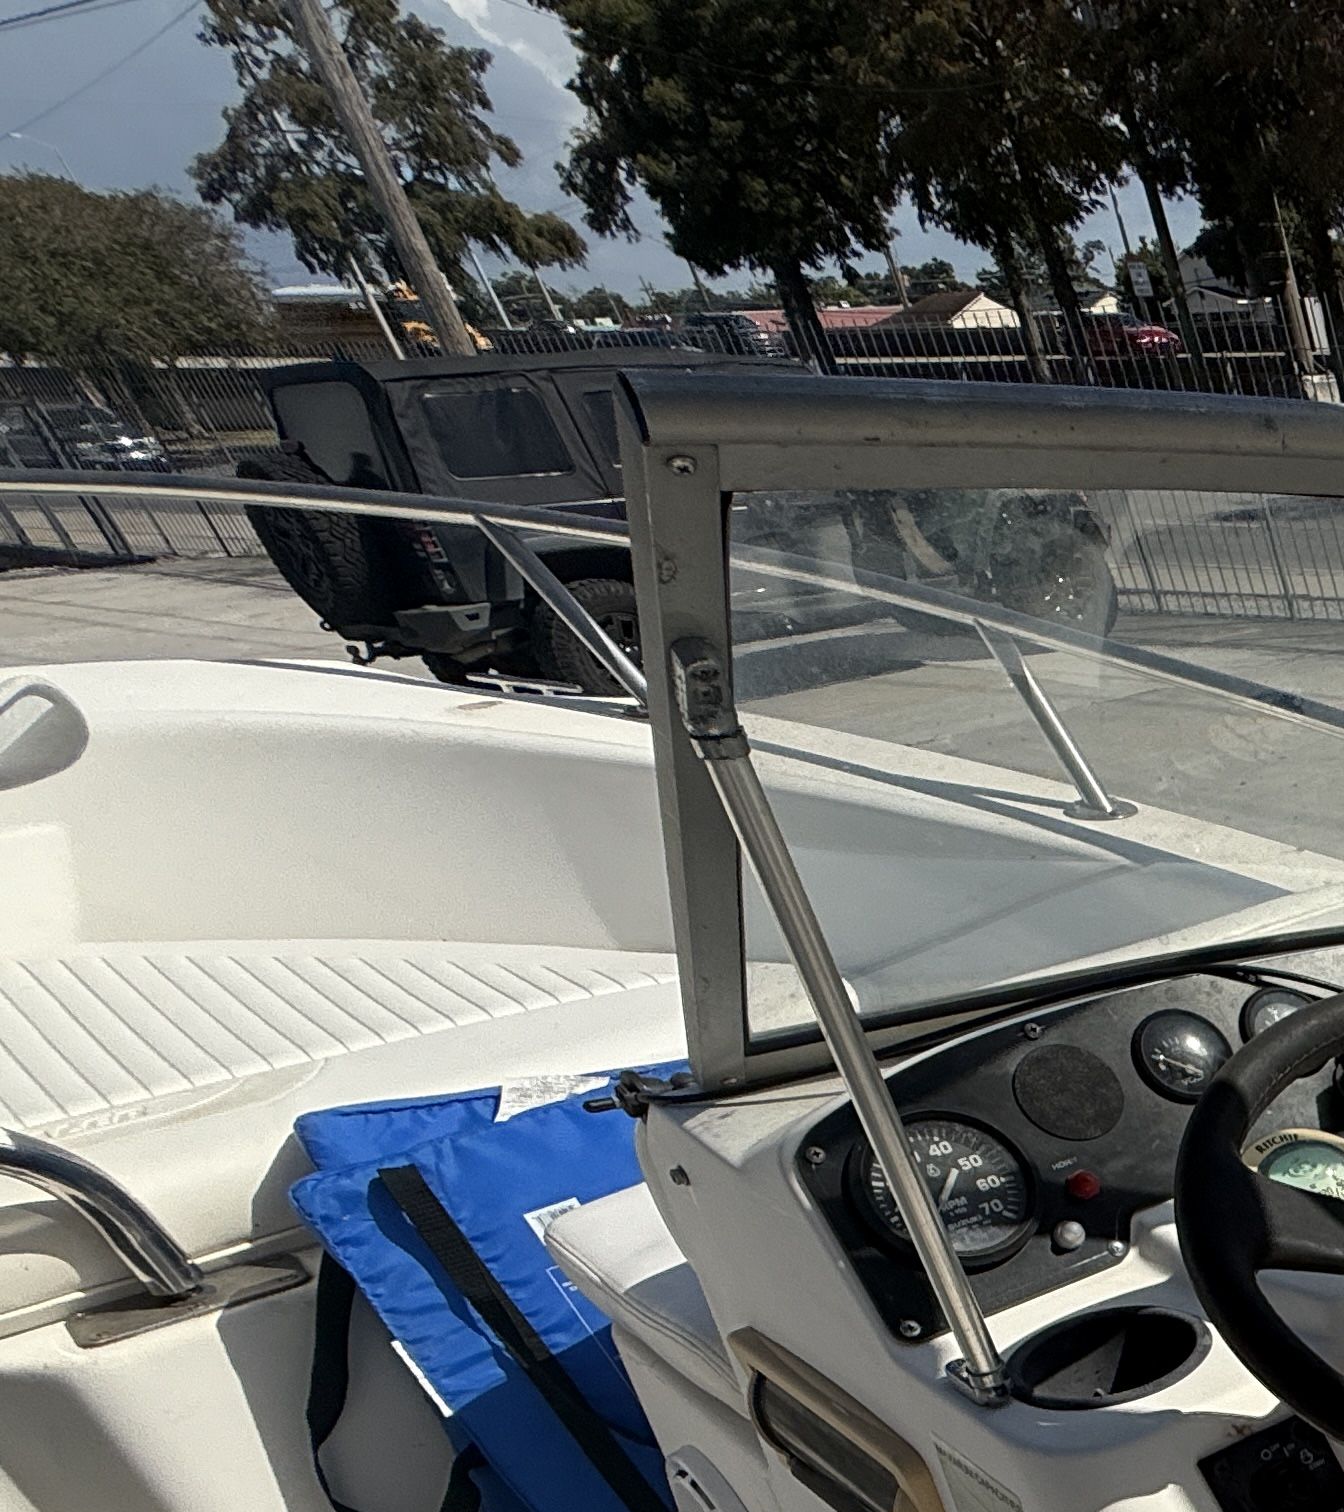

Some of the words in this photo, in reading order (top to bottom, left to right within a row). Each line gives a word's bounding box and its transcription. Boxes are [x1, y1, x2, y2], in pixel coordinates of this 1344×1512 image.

[928, 1140, 953, 1157] 40
[957, 1154, 983, 1171] 50
[976, 1174, 1000, 1192] 60
[979, 1198, 1003, 1216] 70
